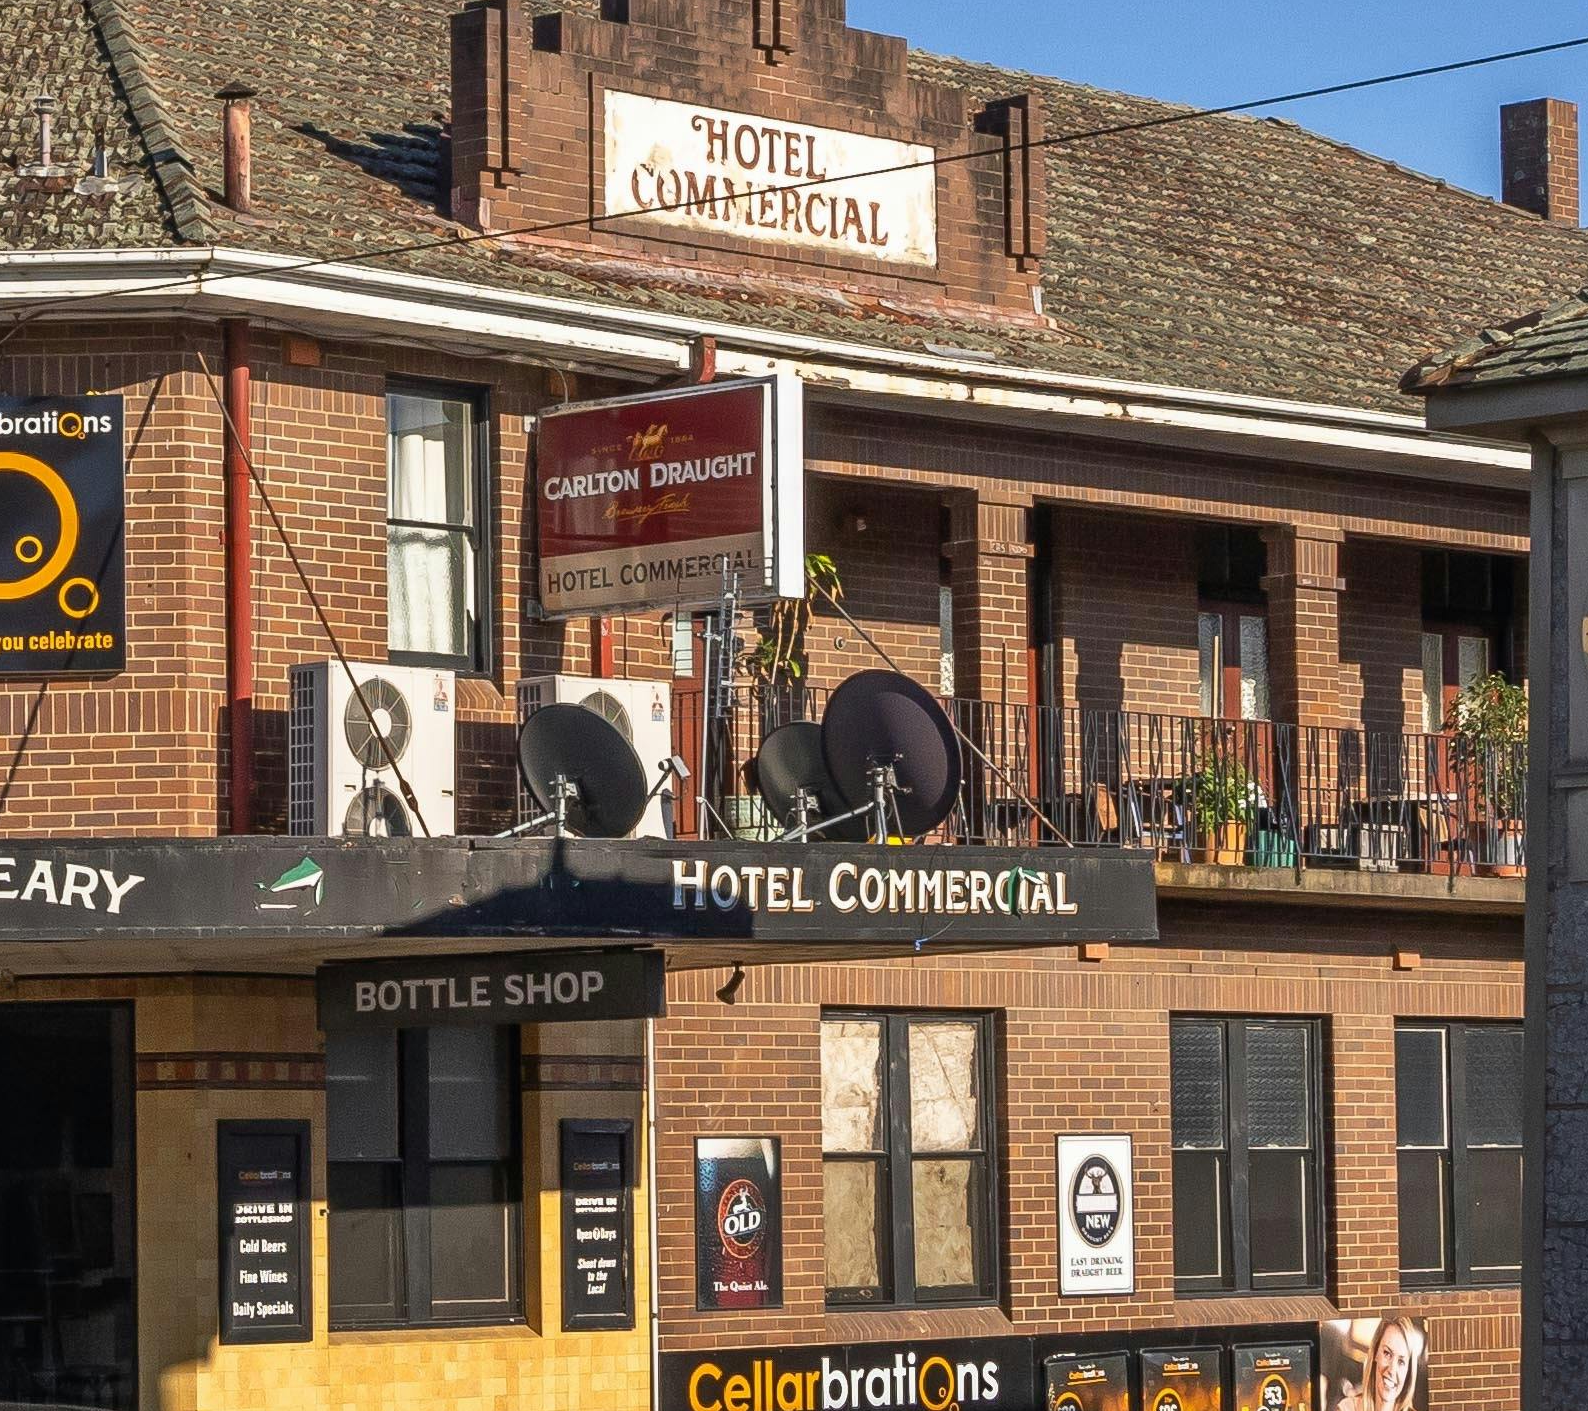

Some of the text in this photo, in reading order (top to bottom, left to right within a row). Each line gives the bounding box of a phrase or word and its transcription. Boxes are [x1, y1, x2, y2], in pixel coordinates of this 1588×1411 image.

[691, 115, 826, 180] HOTEL
[631, 164, 888, 246] COMMERCIAL
[543, 451, 757, 501] CARLTON DRAUGHT
[548, 549, 759, 594] HOTEL COMMERCIAL
[29, 631, 113, 650] celebrate
[671, 859, 1078, 916] HOTEL COMMERCIAL
[355, 970, 605, 1012] BOTTLE SHOP
[235, 1202, 293, 1214] DRIVE IN
[724, 1210, 761, 1236] OLD
[1085, 1213, 1111, 1230] NEW
[576, 1228, 593, 1243] Open
[600, 1227, 617, 1242] Days
[239, 1239, 287, 1254] Cold Beers
[239, 1269, 288, 1285] Fine Wines
[586, 1283, 606, 1295] Local
[713, 1281, 729, 1293] The
[729, 1280, 752, 1294] Quiet
[232, 1301, 294, 1319] Daily Specials
